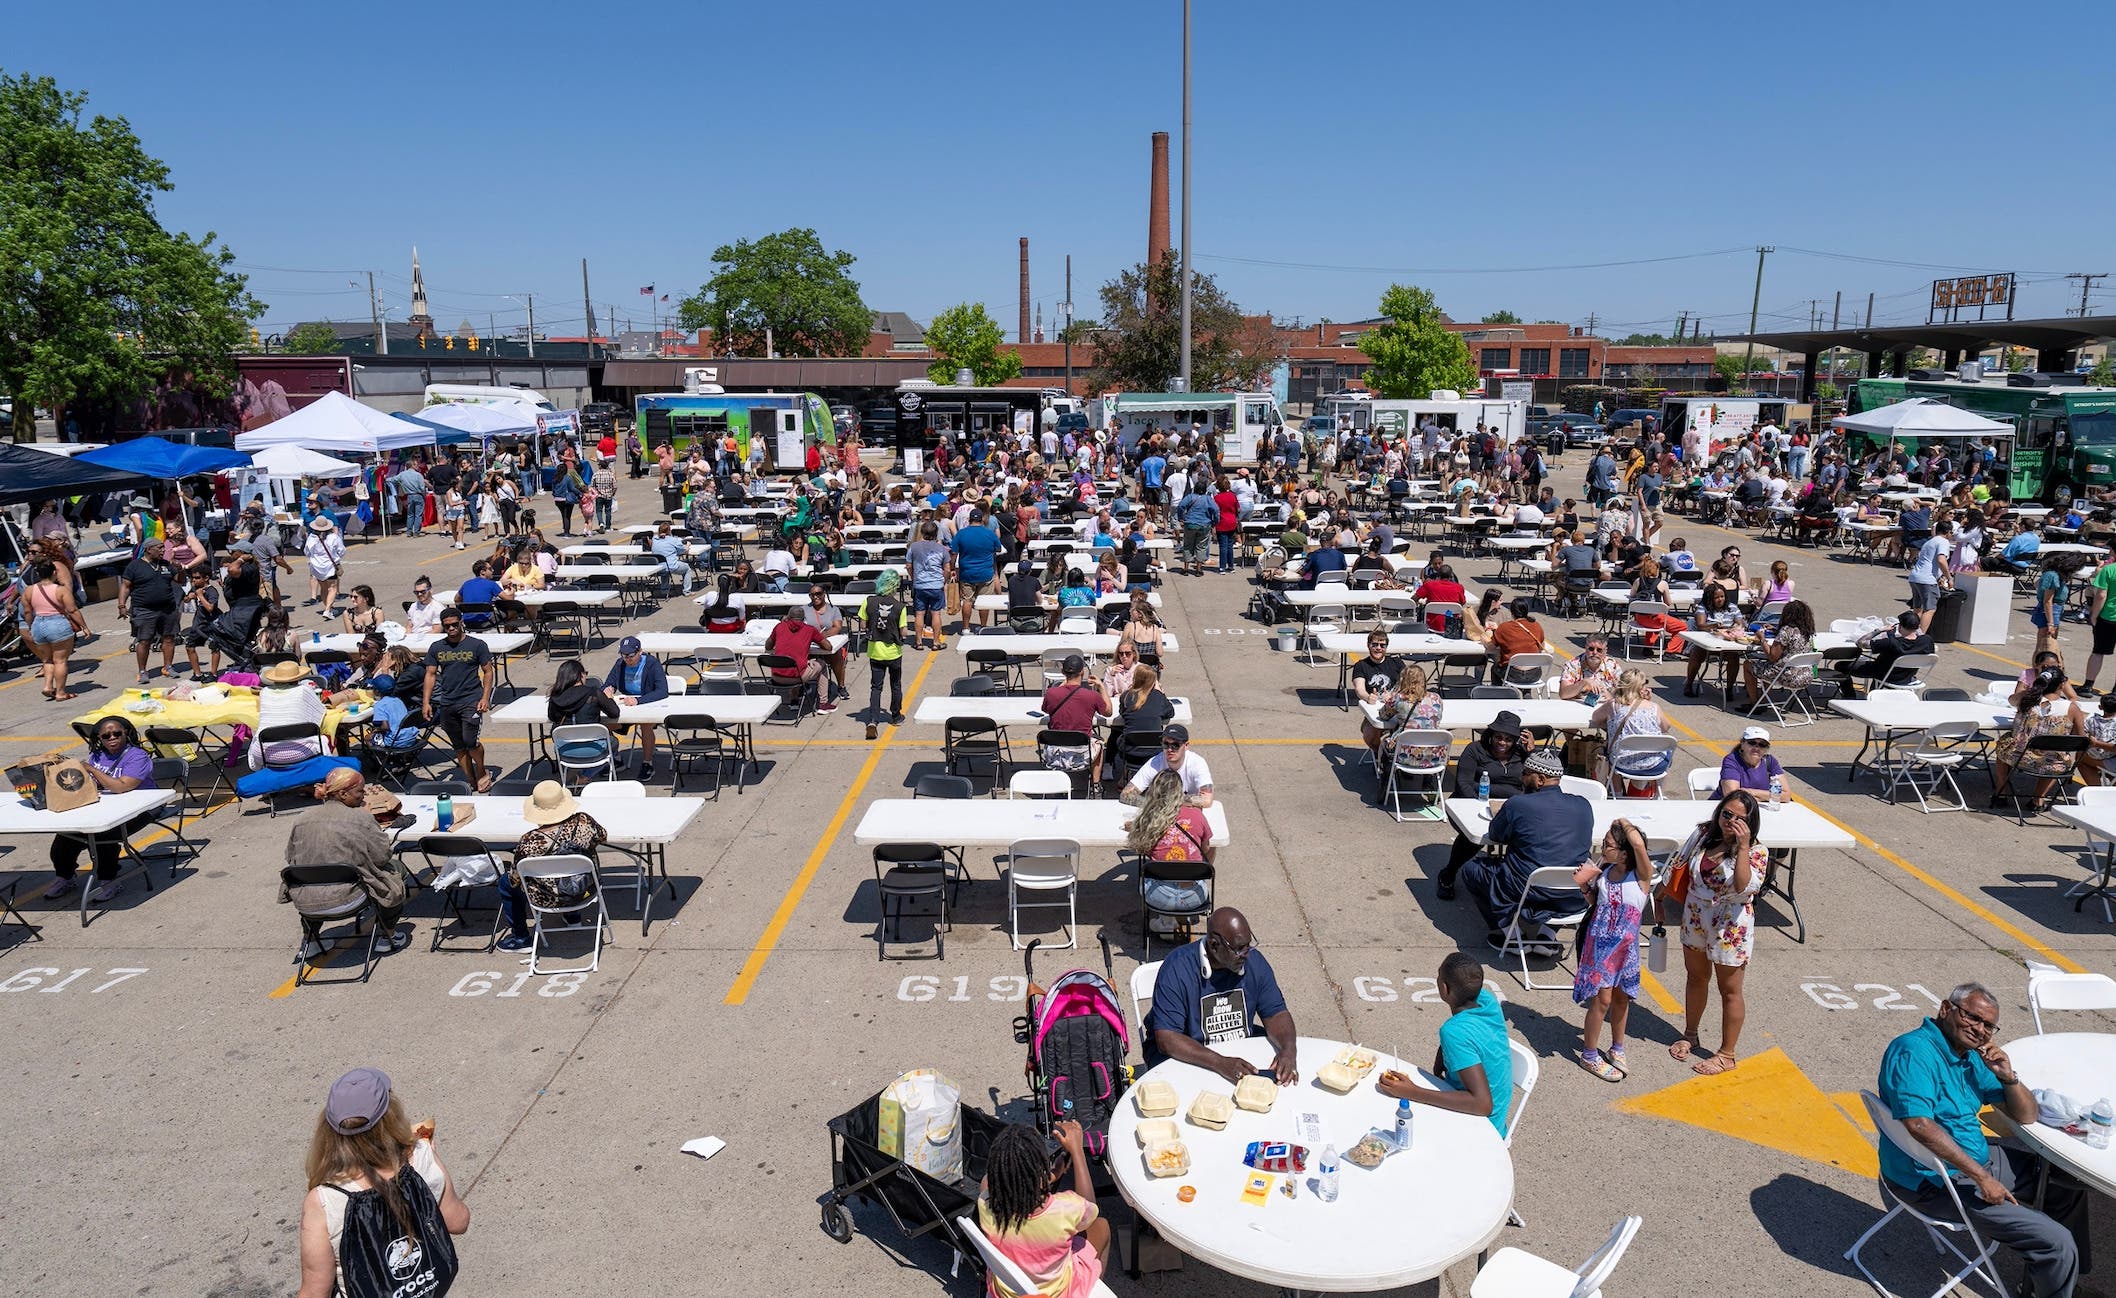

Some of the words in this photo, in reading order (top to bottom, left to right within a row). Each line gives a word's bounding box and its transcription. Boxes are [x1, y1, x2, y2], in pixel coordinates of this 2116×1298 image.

[1936, 277, 1987, 307] SHED
[1992, 275, 2008, 303] 6
[1126, 413, 1160, 425] Tacos
[0, 967, 150, 993] 617
[448, 971, 589, 998] 618
[897, 975, 1028, 1002] 619
[1800, 983, 1943, 1010] 621
[1208, 1015, 1220, 1024] ALL
[1220, 1012, 1242, 1021] LIVES
[392, 1269, 435, 1298] crocs
